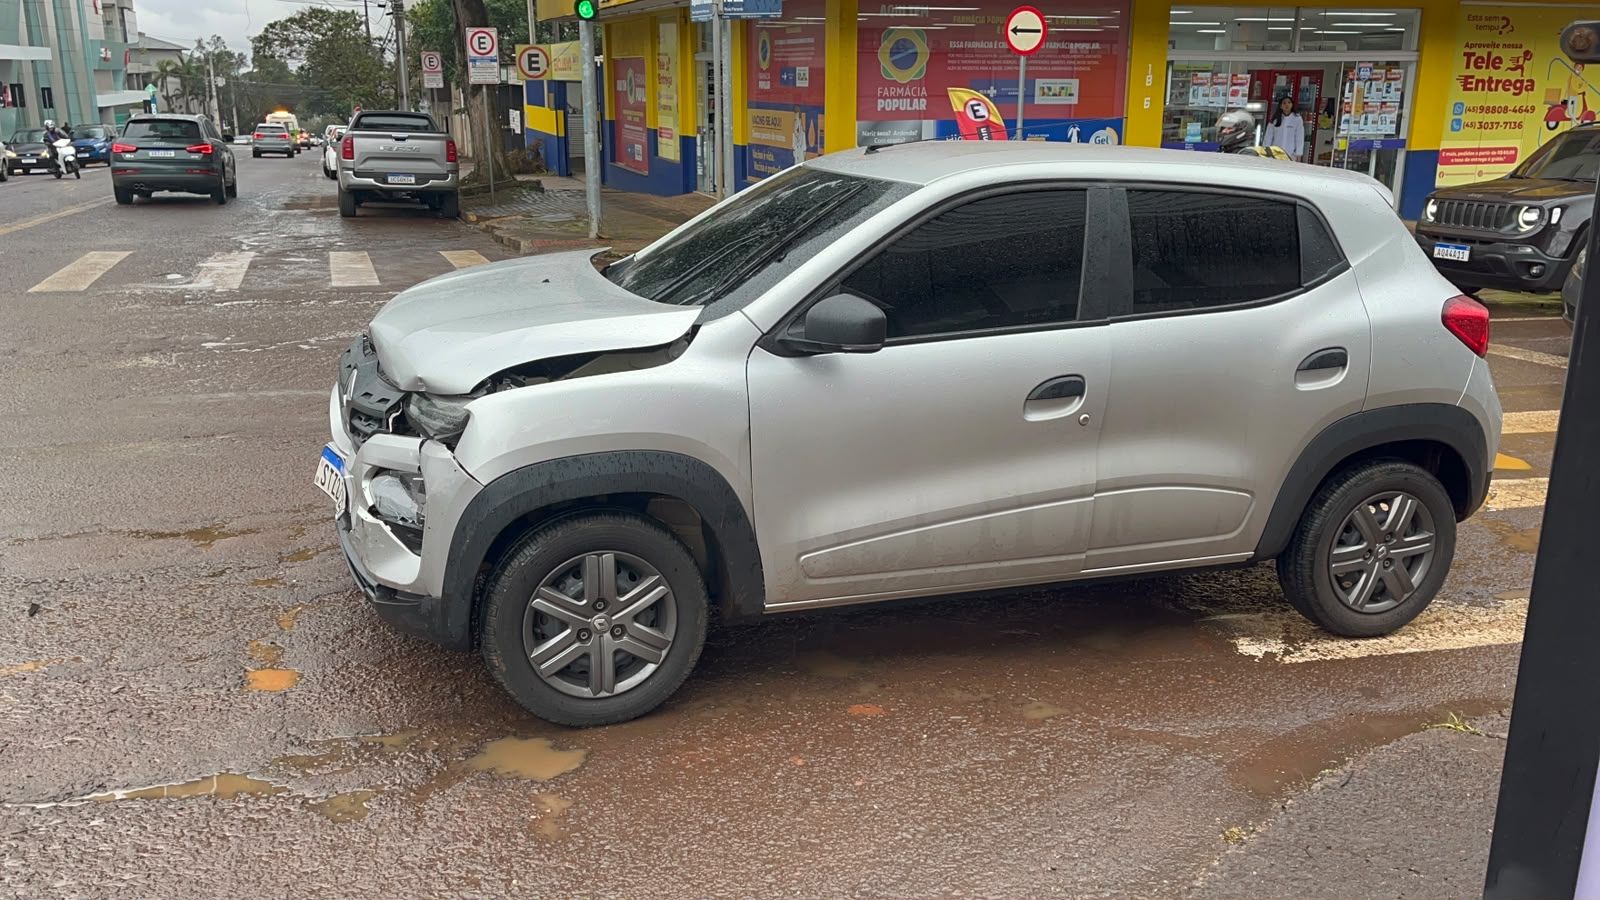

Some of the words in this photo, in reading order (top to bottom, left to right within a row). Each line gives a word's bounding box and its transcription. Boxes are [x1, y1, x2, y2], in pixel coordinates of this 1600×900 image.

[478, 36, 487, 50] E
[1464, 41, 1500, 49] Aproveite
[428, 57, 435, 67] E
[527, 53, 540, 72] E
[1463, 51, 1503, 70] Tele
[877, 85, 927, 97] FARMÁCIA
[1460, 75, 1535, 96] Entrega
[877, 98, 927, 111] POPULAR
[970, 103, 986, 119] E
[1477, 121, 1523, 130] 3037-7136
[1094, 135, 1109, 145] Gel
